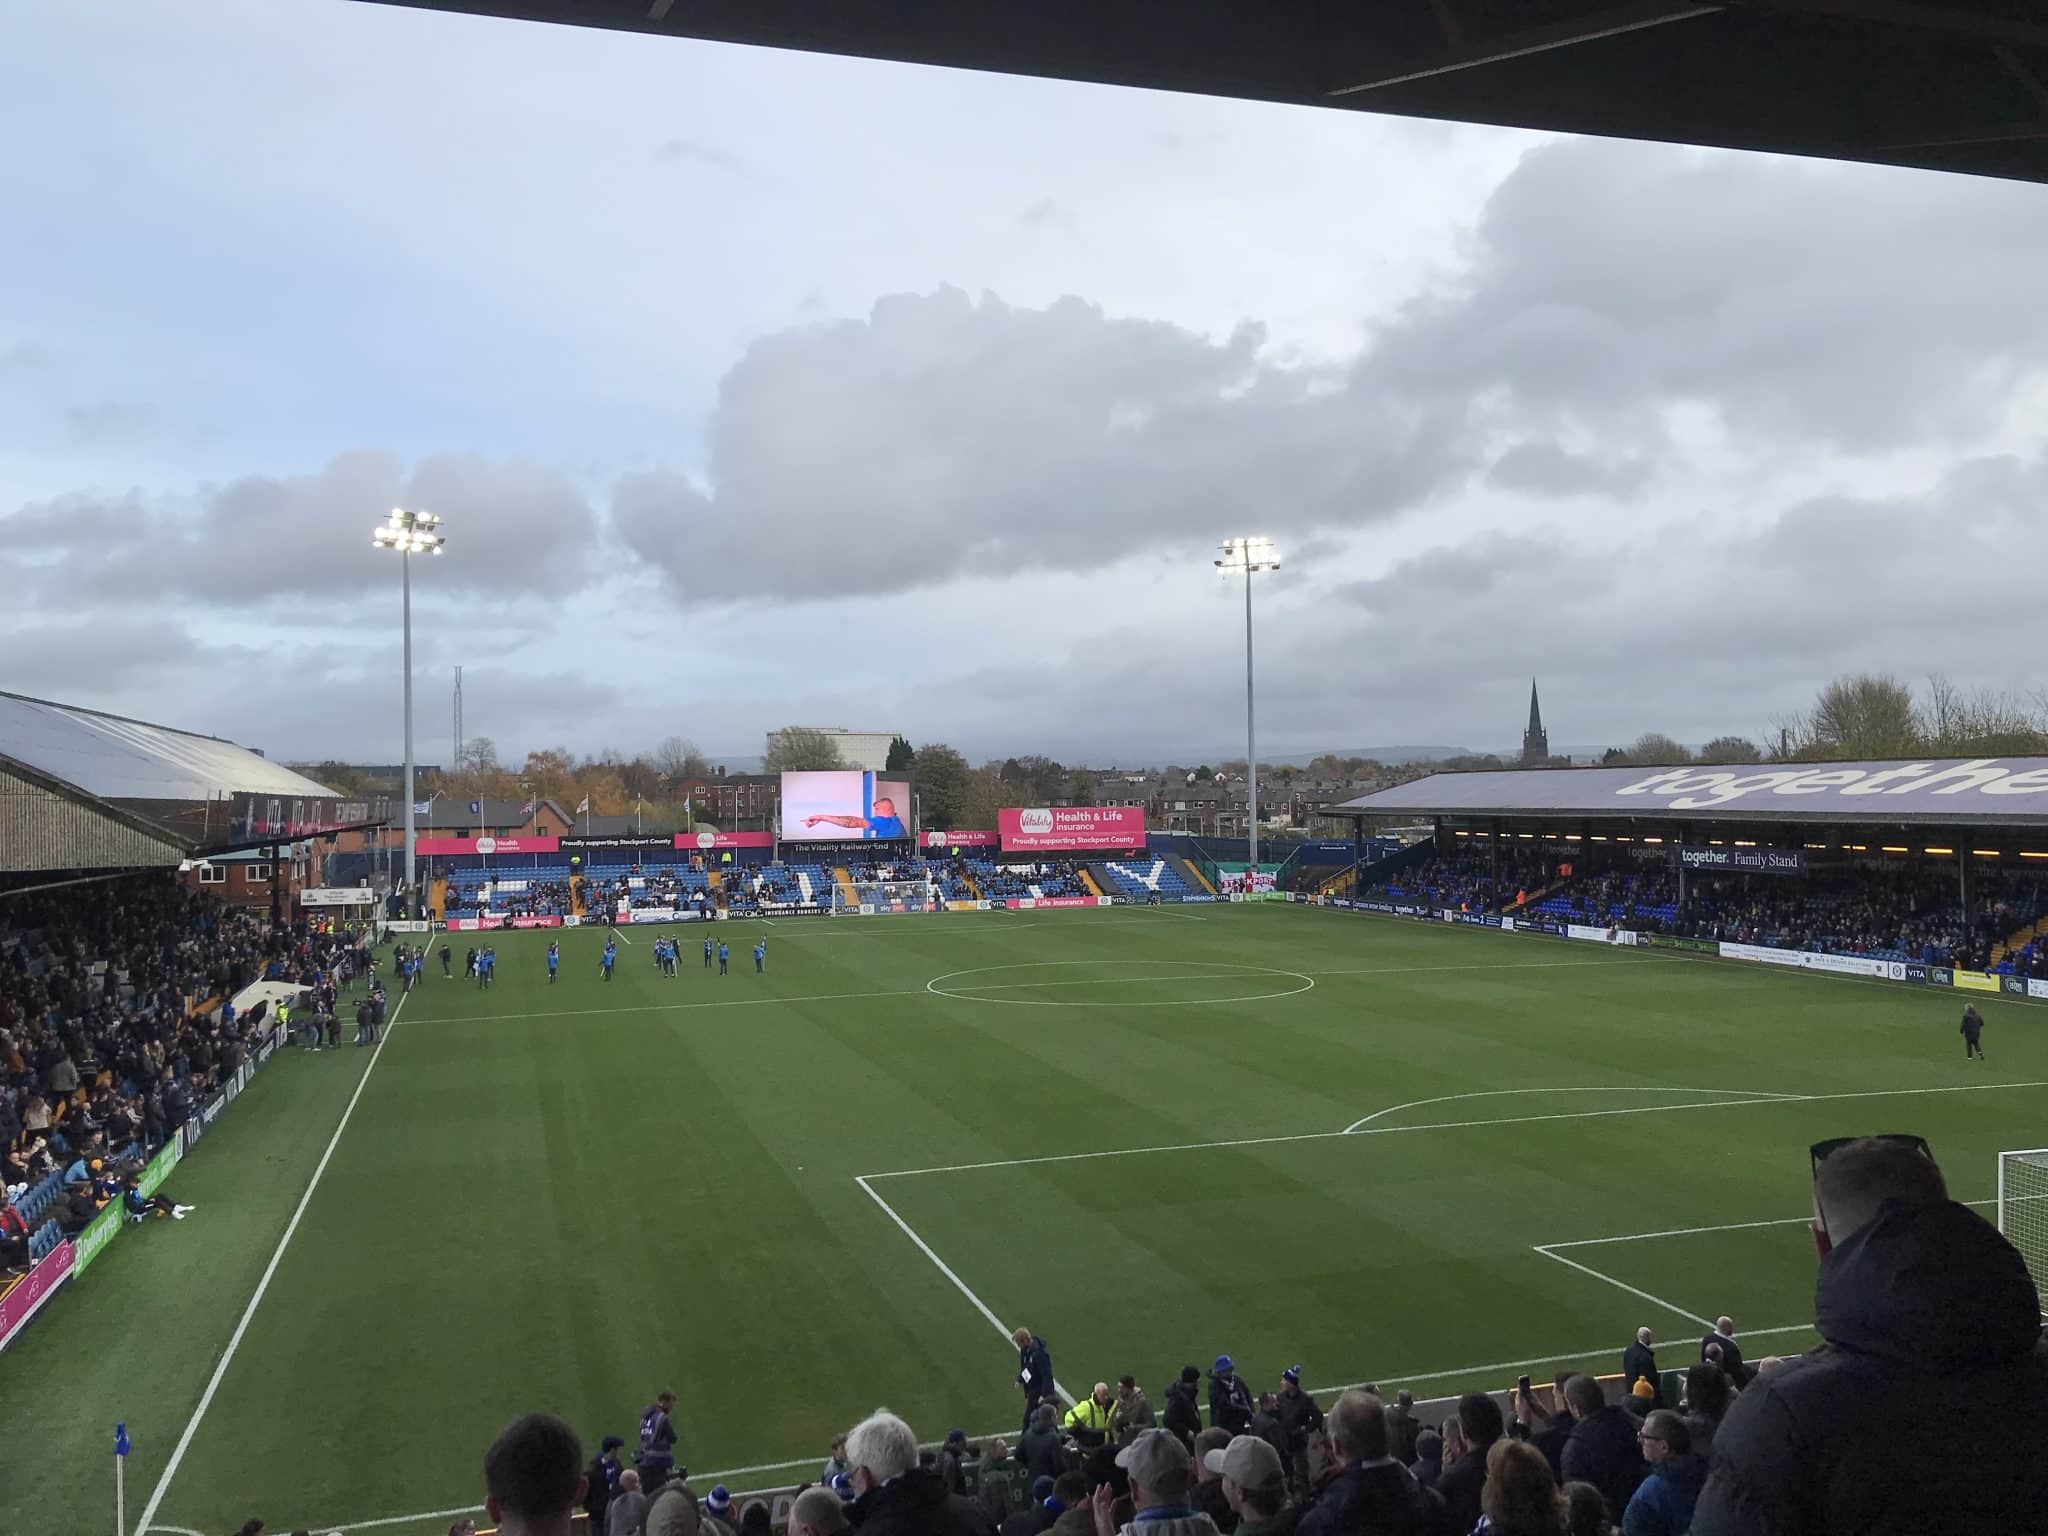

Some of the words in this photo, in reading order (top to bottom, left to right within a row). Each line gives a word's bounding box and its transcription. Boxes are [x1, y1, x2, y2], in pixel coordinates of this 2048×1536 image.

[1021, 813, 1051, 827] Vitality
[1056, 811, 1091, 822] Health
[1093, 811, 1101, 821] &
[1103, 810, 1123, 821] Life
[1056, 822, 1095, 831] insurance
[947, 832, 968, 840] Health
[1012, 837, 1038, 847] Proudly
[1039, 837, 1076, 846] supporting
[1077, 835, 1109, 845] Stockport
[1110, 835, 1135, 845] County
[561, 839, 585, 848] Proudly
[585, 839, 618, 848] supporting
[619, 838, 649, 846] Stockport
[650, 837, 671, 846] County
[795, 843, 810, 852] The
[810, 843, 839, 852] Vitality
[840, 842, 872, 852] Railway
[871, 842, 889, 850] End
[1734, 851, 1768, 869] Family
[1768, 852, 1798, 868] Stand
[1038, 899, 1051, 907] Life
[1052, 898, 1085, 906] insurance
[880, 904, 891, 913] sky
[512, 917, 552, 928] insurance
[1907, 968, 1926, 979] VITA
